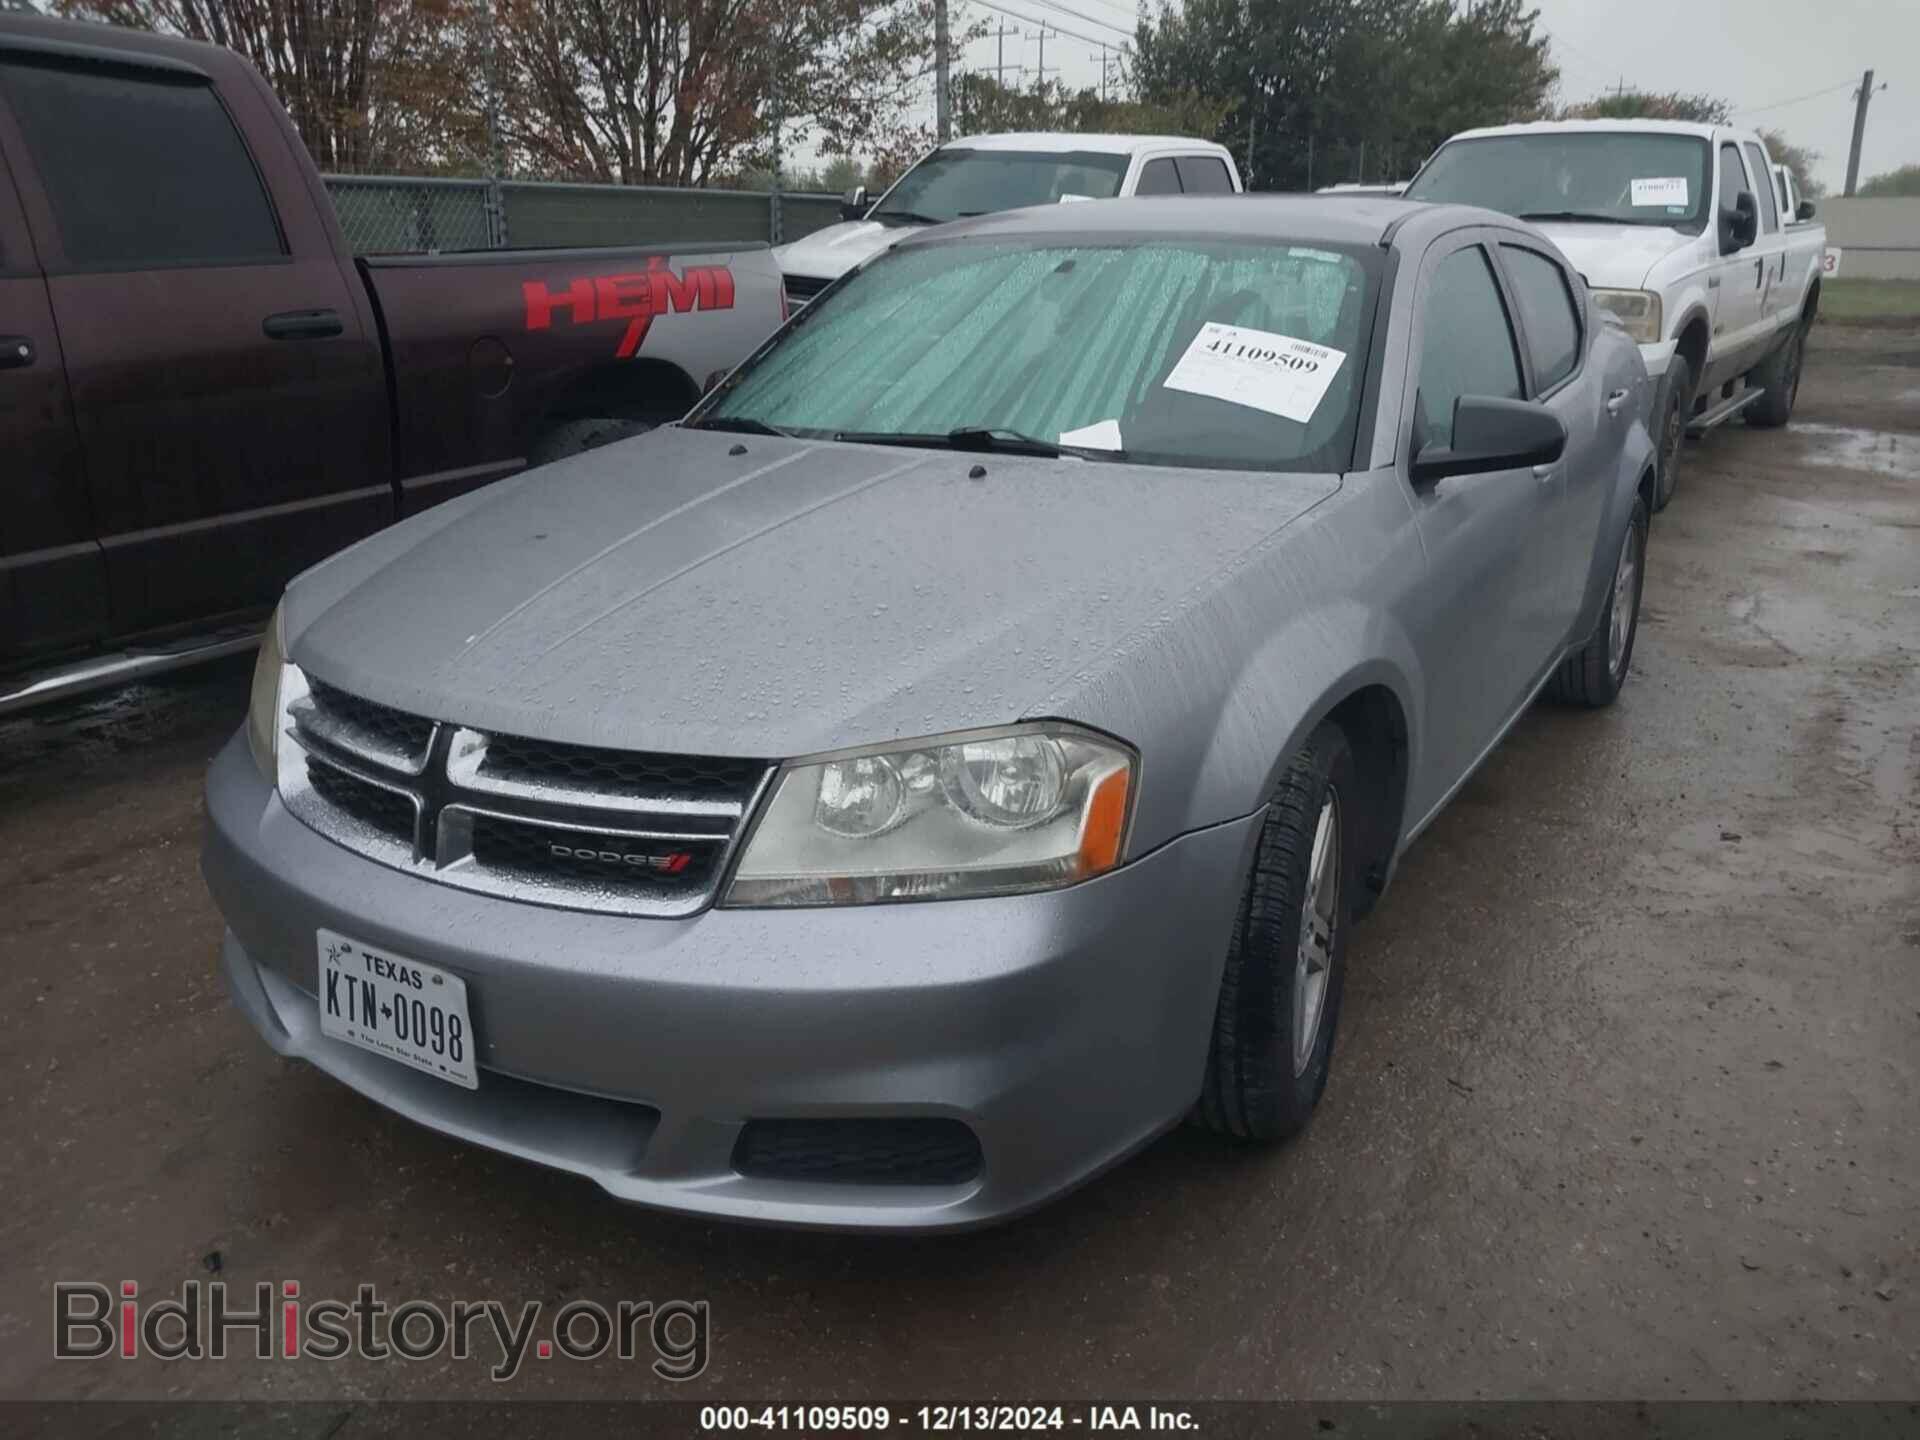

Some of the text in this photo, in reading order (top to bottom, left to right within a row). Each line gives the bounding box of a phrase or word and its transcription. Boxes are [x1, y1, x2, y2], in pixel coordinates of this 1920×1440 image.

[522, 264, 735, 331] HEMI
[1206, 339, 1320, 374] 41109509
[550, 844, 671, 867] DODGE
[362, 952, 423, 990] TEXAS
